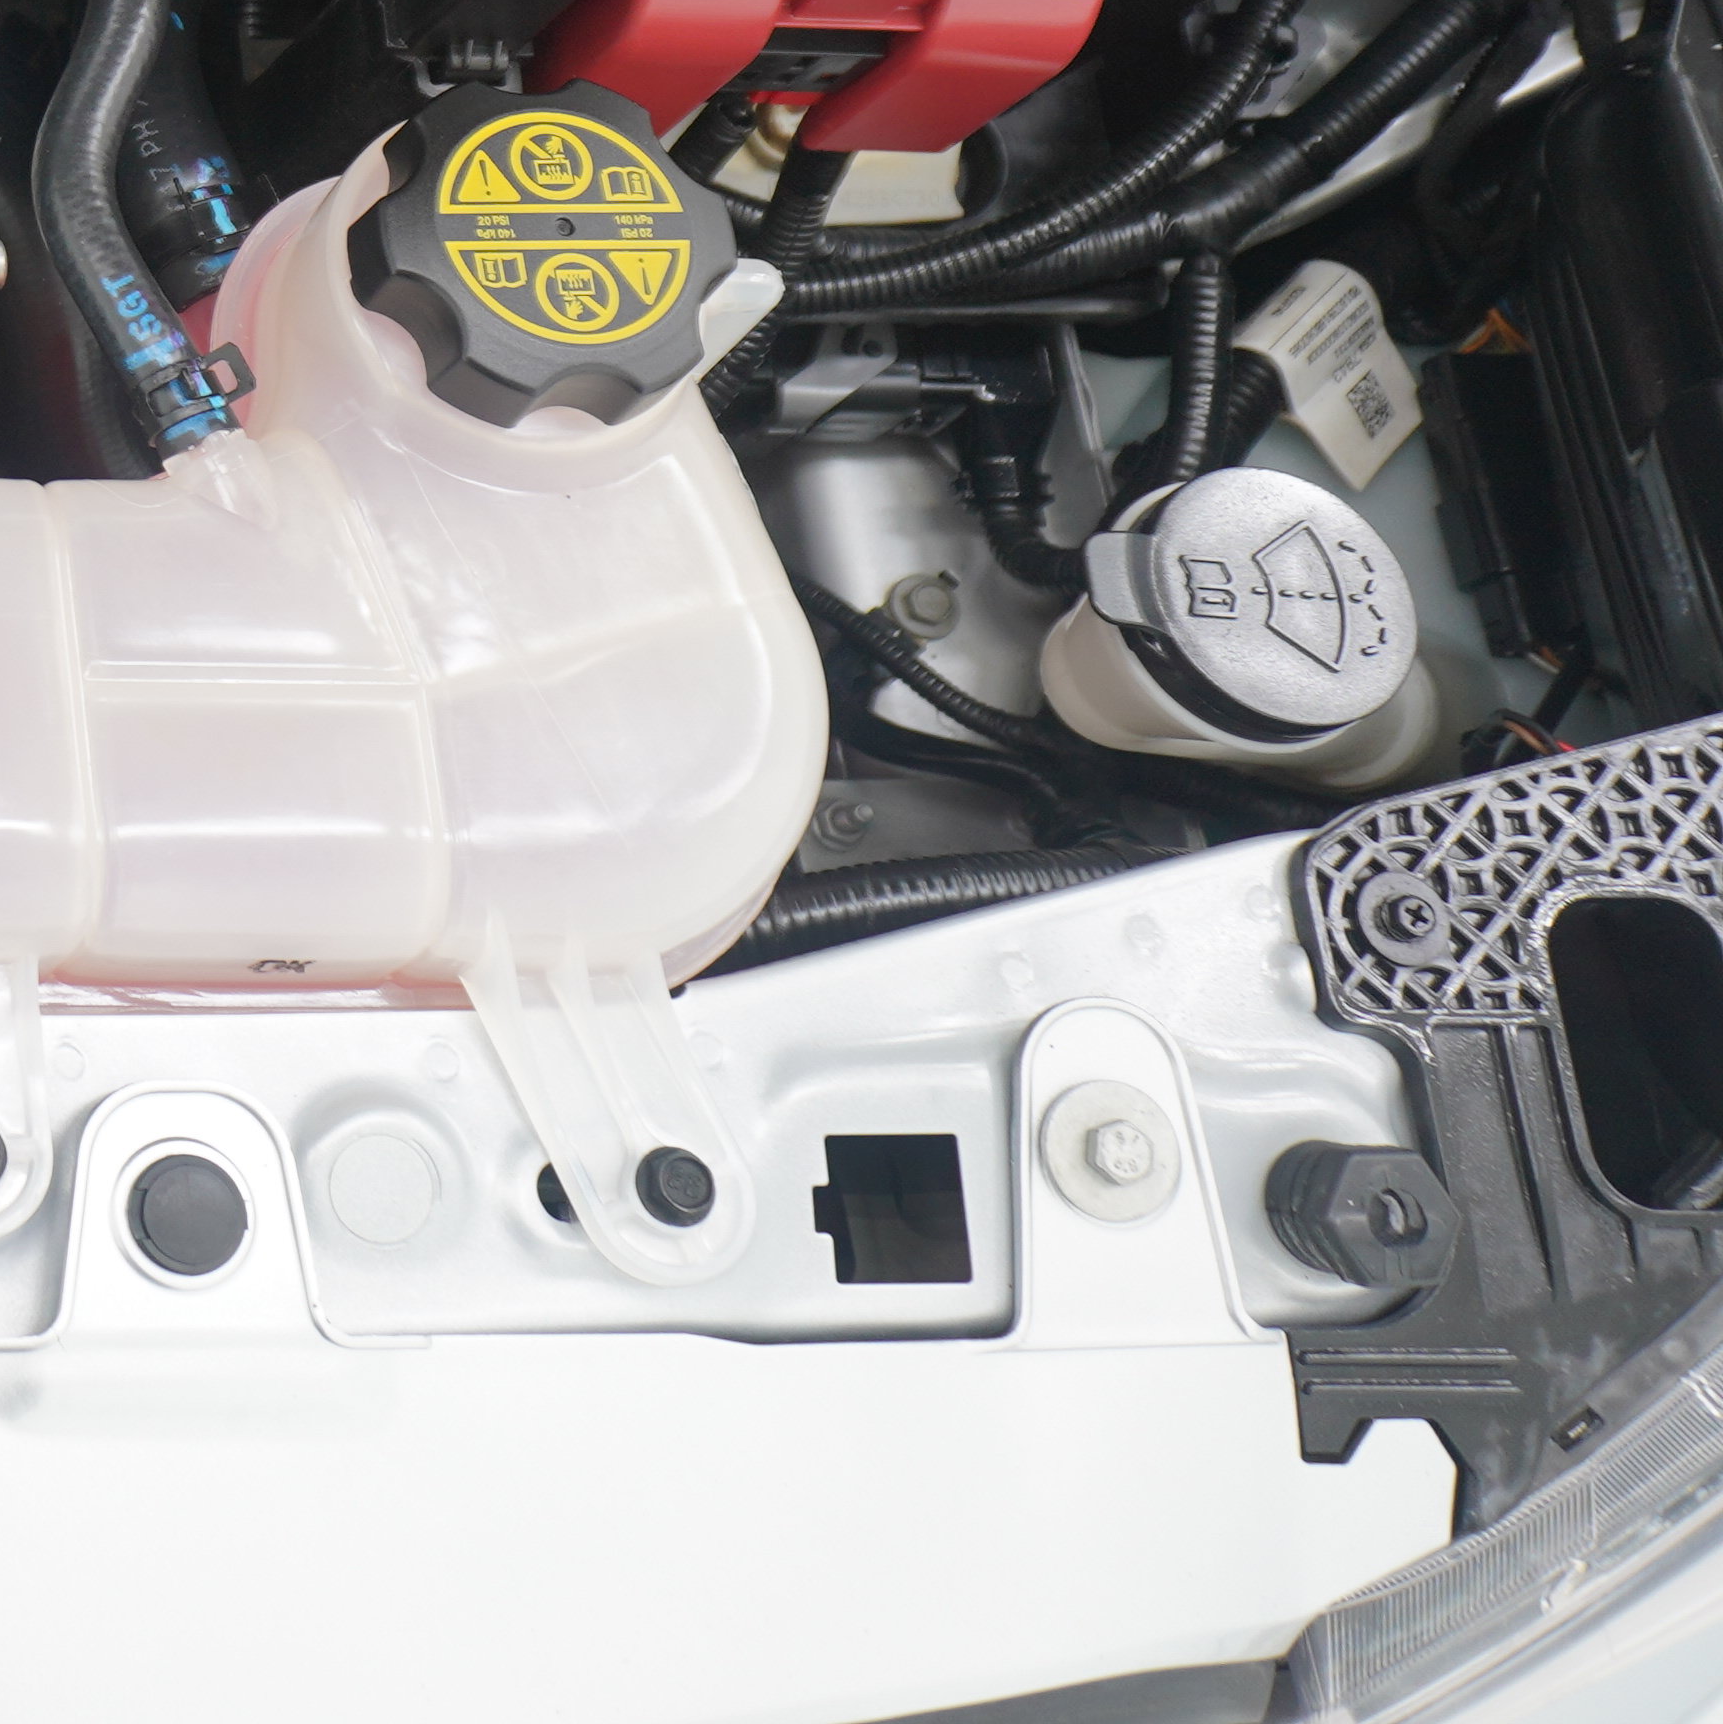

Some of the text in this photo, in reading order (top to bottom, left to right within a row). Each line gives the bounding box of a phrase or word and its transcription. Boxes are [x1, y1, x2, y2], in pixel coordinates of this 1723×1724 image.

[477, 214, 510, 226] 20 PSI
[614, 214, 633, 225] 140
[498, 228, 516, 239] 140
[620, 227, 653, 238] 20 PSI
